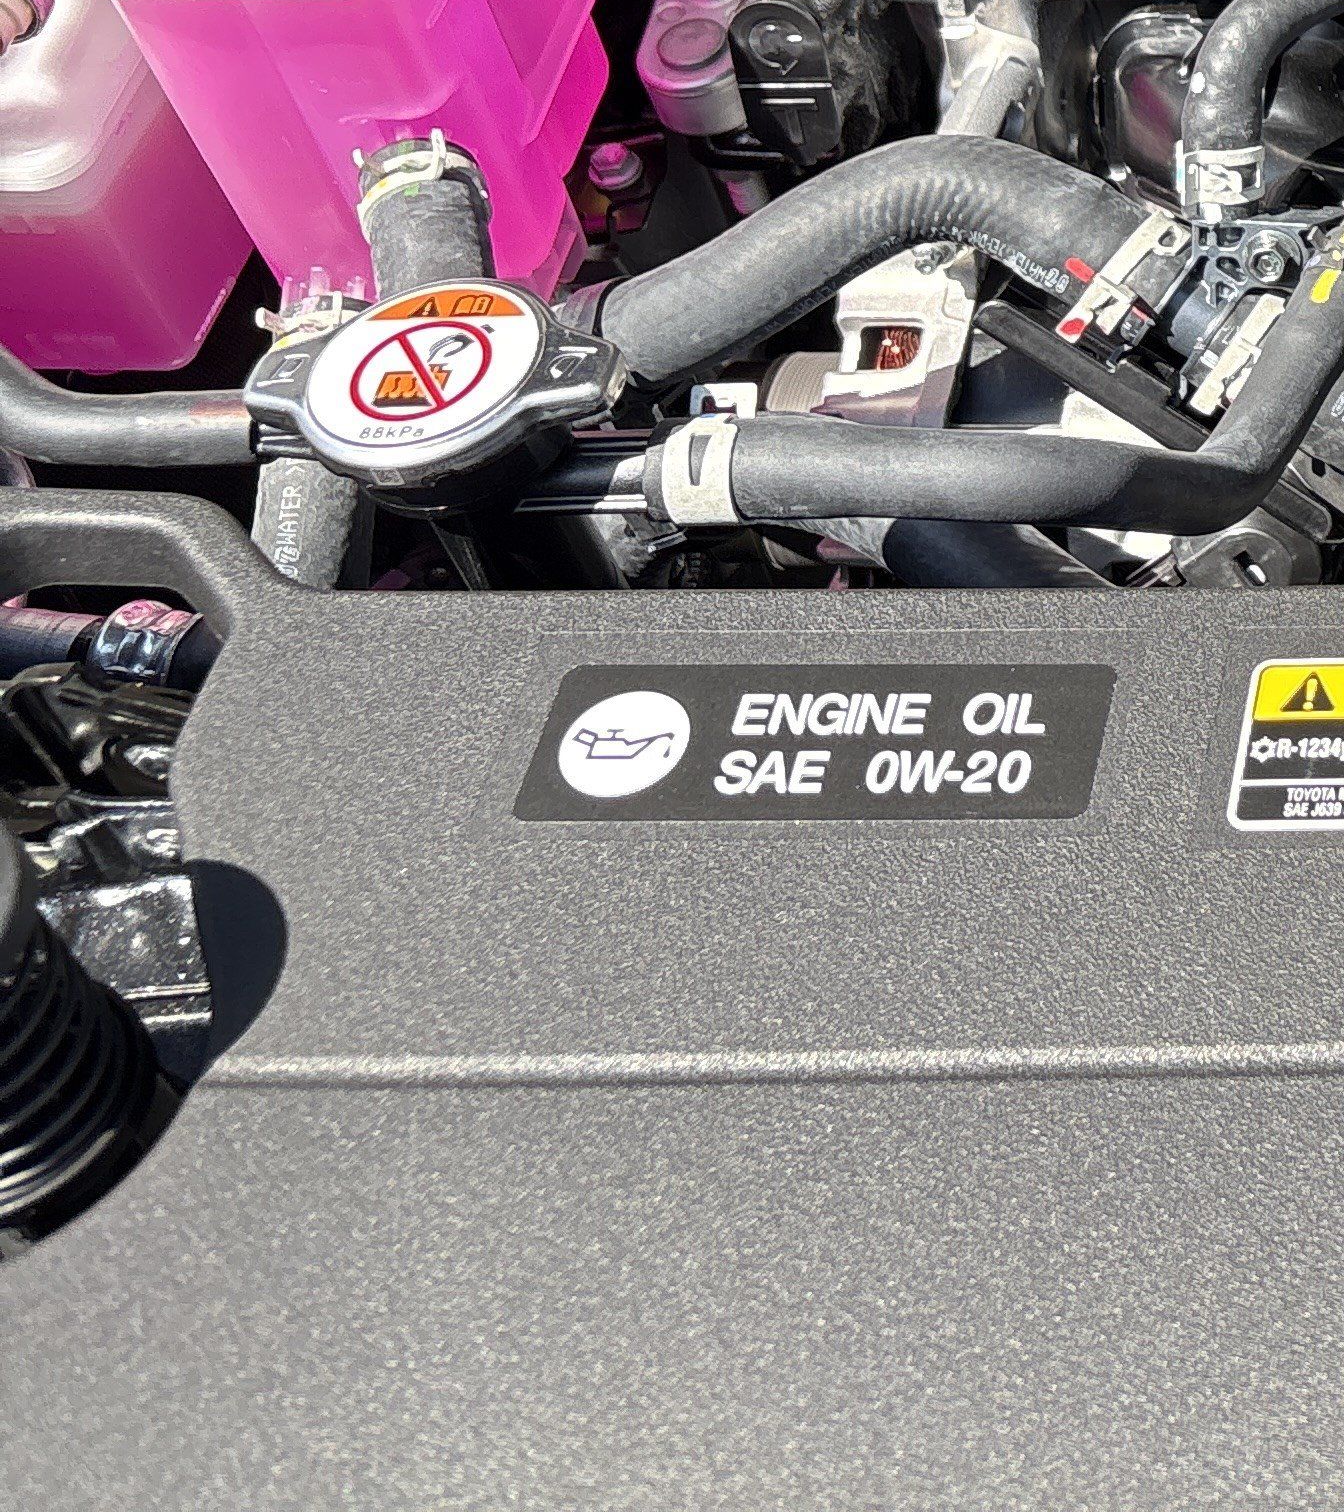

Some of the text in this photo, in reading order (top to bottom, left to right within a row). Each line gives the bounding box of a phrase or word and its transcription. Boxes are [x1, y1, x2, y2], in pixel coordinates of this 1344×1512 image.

[359, 425, 425, 439] 88kPa
[276, 484, 303, 547] WATER
[731, 691, 1047, 738] ENGINE OIL
[713, 749, 1032, 796] SAE 0W-20
[1286, 787, 1336, 801] TOYOTA
[1283, 803, 1308, 817] SAE
